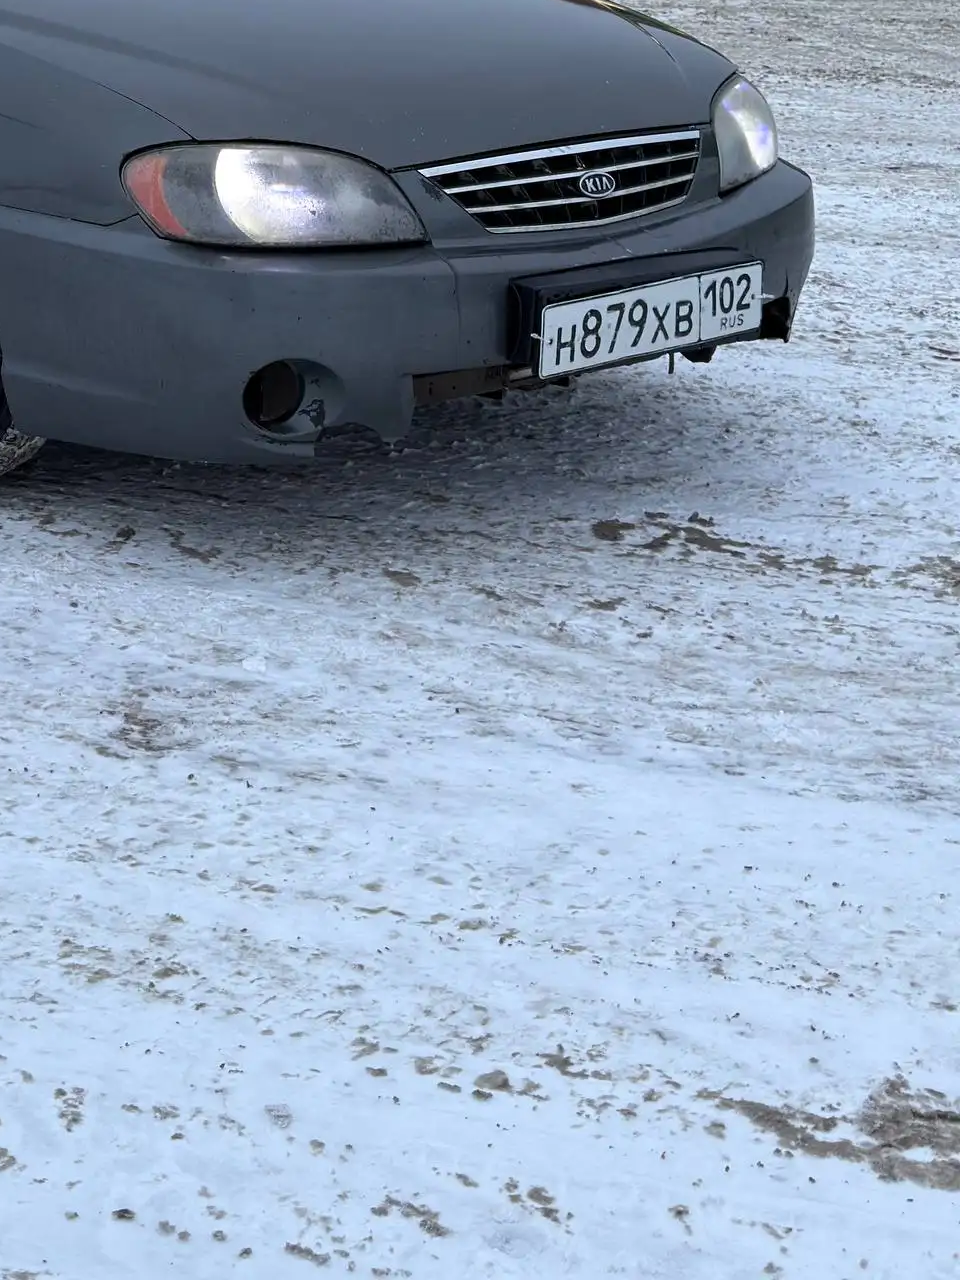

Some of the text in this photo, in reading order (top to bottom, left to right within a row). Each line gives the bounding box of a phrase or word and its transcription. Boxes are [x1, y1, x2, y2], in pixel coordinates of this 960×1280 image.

[586, 176, 611, 193] KIA
[555, 273, 752, 366] Н879ХВ 102
[719, 313, 745, 331] RUS
